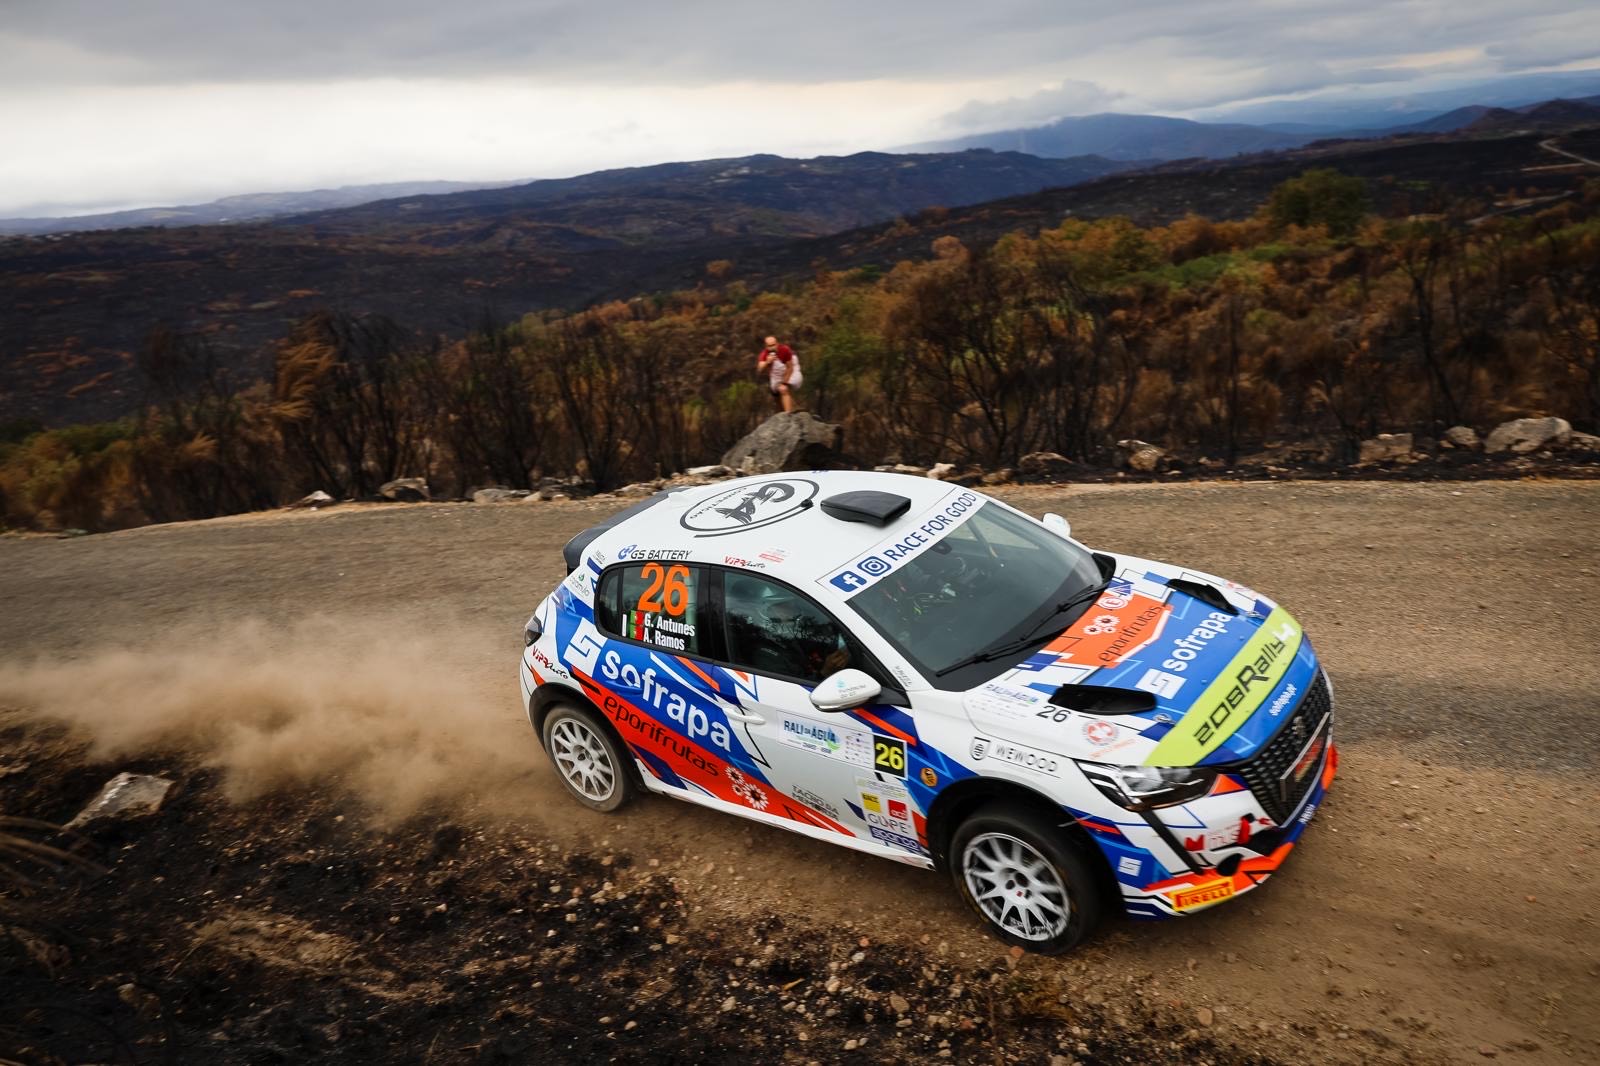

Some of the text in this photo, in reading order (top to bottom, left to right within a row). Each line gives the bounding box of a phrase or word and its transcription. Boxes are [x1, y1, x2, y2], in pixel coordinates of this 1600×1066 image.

[883, 492, 977, 562] RACE FOR GOOD
[630, 549, 693, 560] GS BATTERY
[637, 562, 691, 617] 26
[644, 613, 696, 637] G. Antunes
[1098, 605, 1163, 663] eporifrutas
[642, 628, 685, 651] A. Ramos
[1162, 611, 1234, 672] sofrapa
[601, 650, 732, 753] sofrapa
[1036, 705, 1071, 723] 26
[603, 696, 720, 777] eporifrutas
[783, 720, 803, 735] RALI
[875, 742, 904, 771] 26
[995, 744, 1059, 772] WEWOOD
[1174, 882, 1232, 908] PIRELLI
